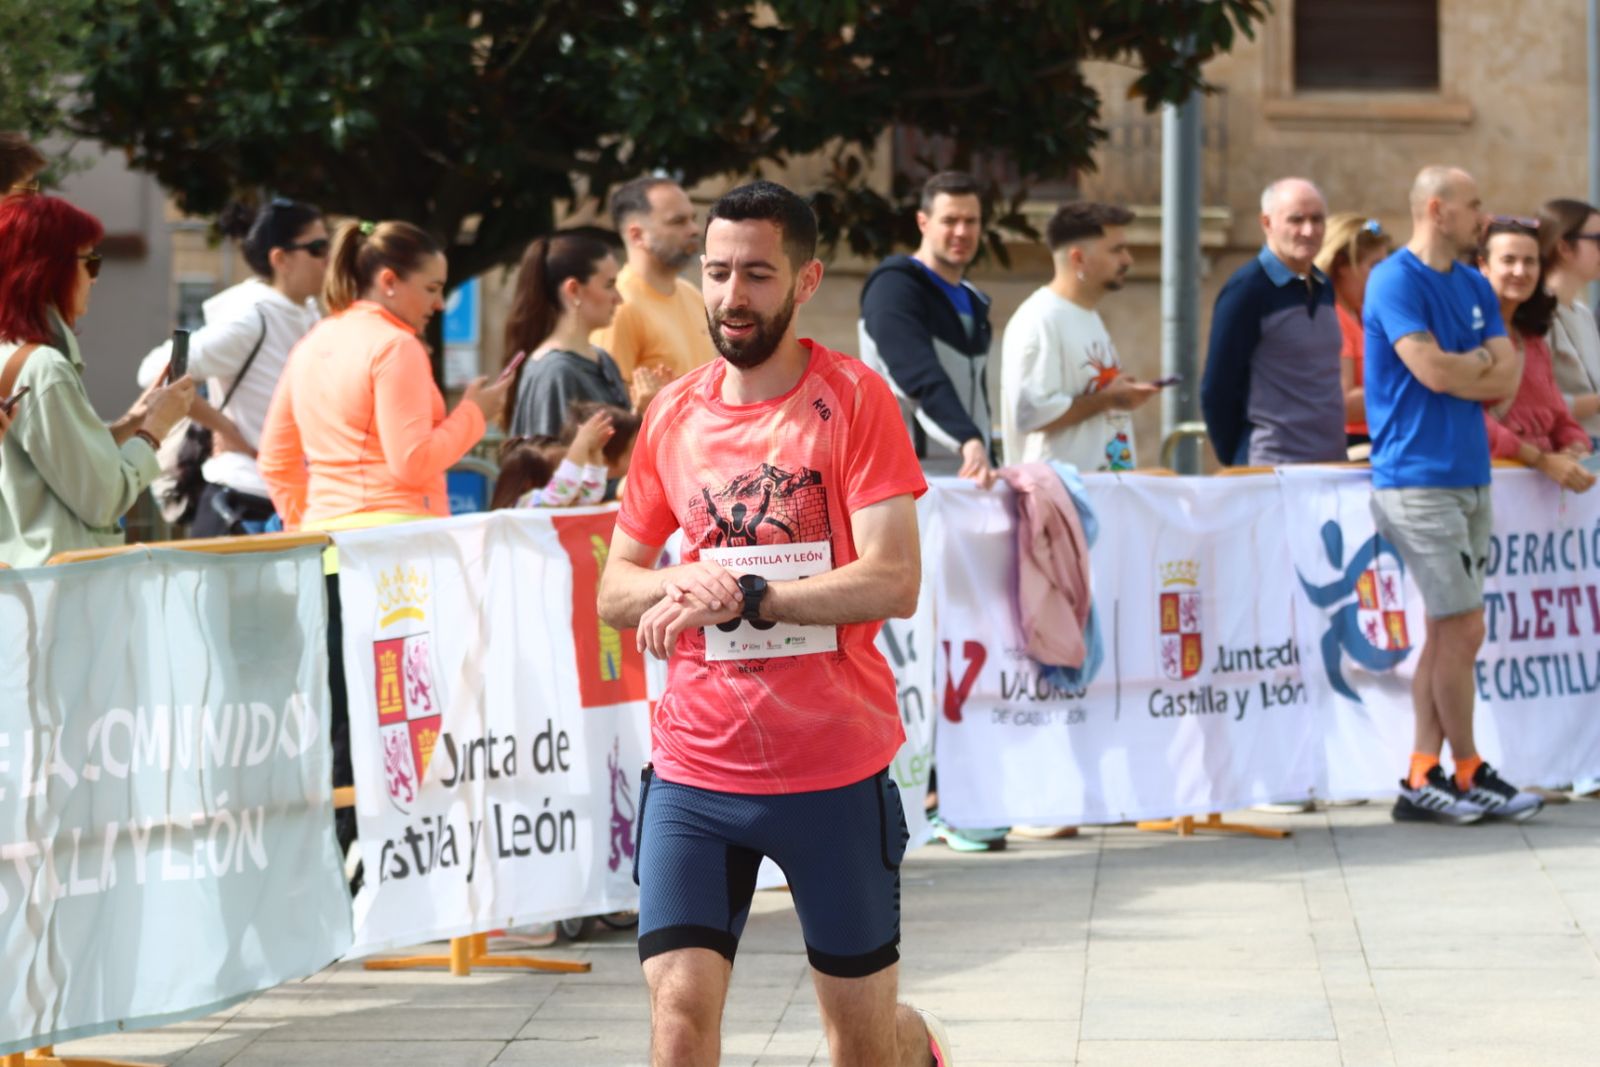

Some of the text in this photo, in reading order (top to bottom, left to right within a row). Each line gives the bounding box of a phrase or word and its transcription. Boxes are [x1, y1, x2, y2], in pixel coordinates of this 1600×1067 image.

[735, 554, 783, 567] CASTILLA
[784, 553, 792, 563] Y
[793, 550, 823, 563] LEÓN
[1234, 689, 1249, 721] y
[1260, 677, 1308, 709] Lón
[1494, 651, 1600, 699] CASTILL
[532, 718, 570, 775] de
[466, 820, 482, 883] y
[493, 797, 577, 858] León
